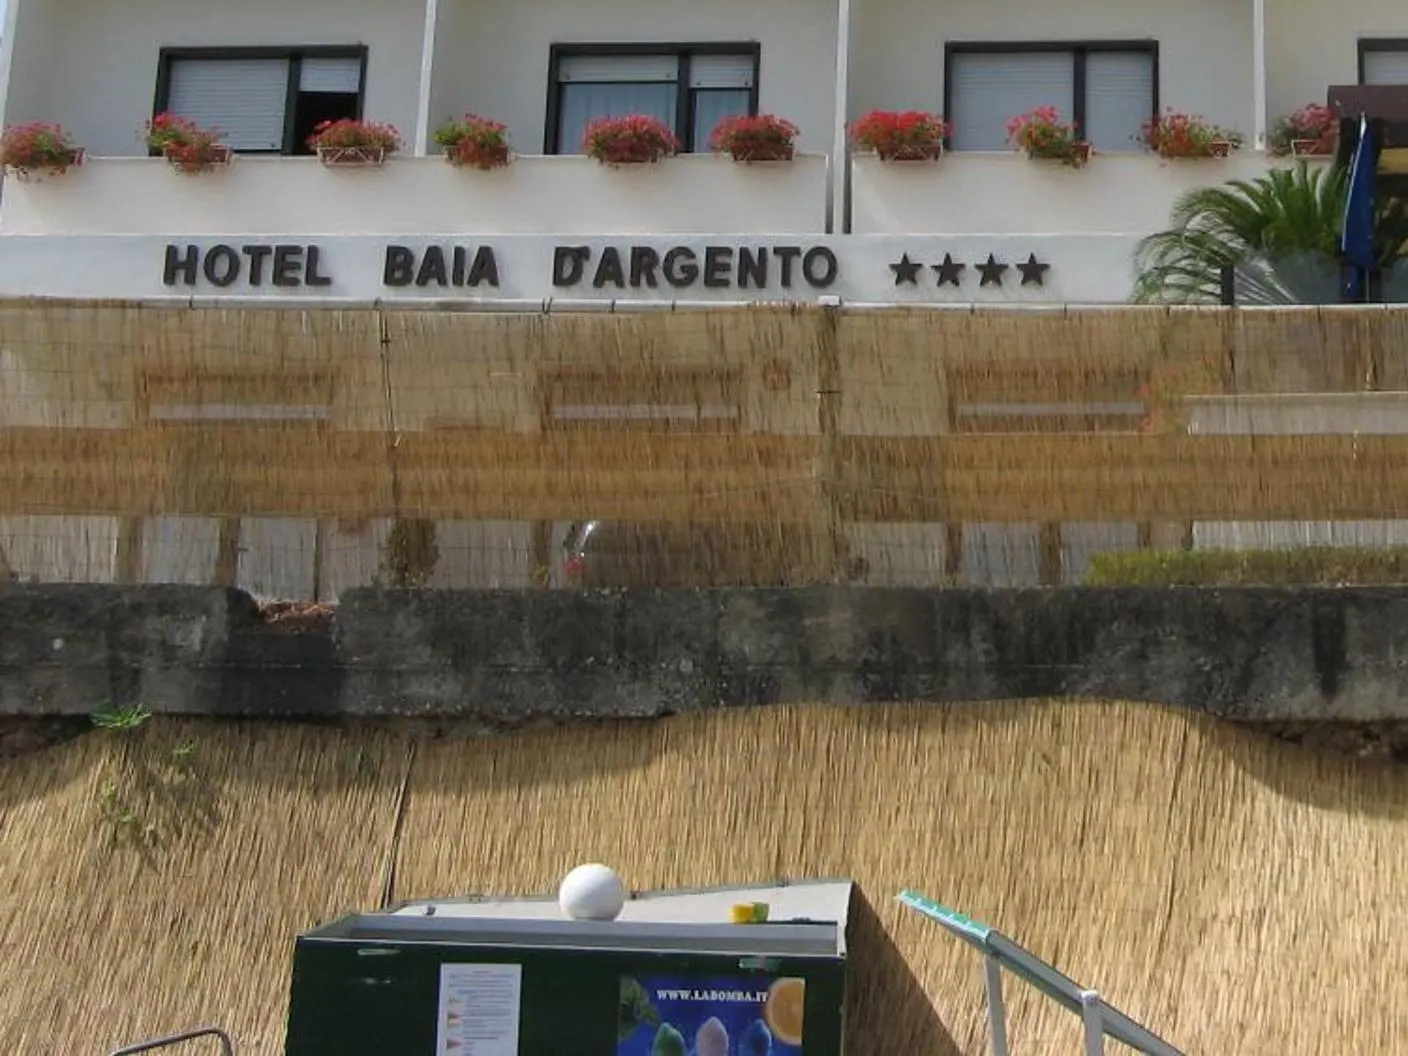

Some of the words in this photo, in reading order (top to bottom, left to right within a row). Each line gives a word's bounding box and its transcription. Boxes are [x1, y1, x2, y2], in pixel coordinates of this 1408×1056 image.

[163, 244, 333, 287] HOTEL
[383, 245, 500, 287] BAIA
[552, 246, 839, 288] D'ARGENTO
